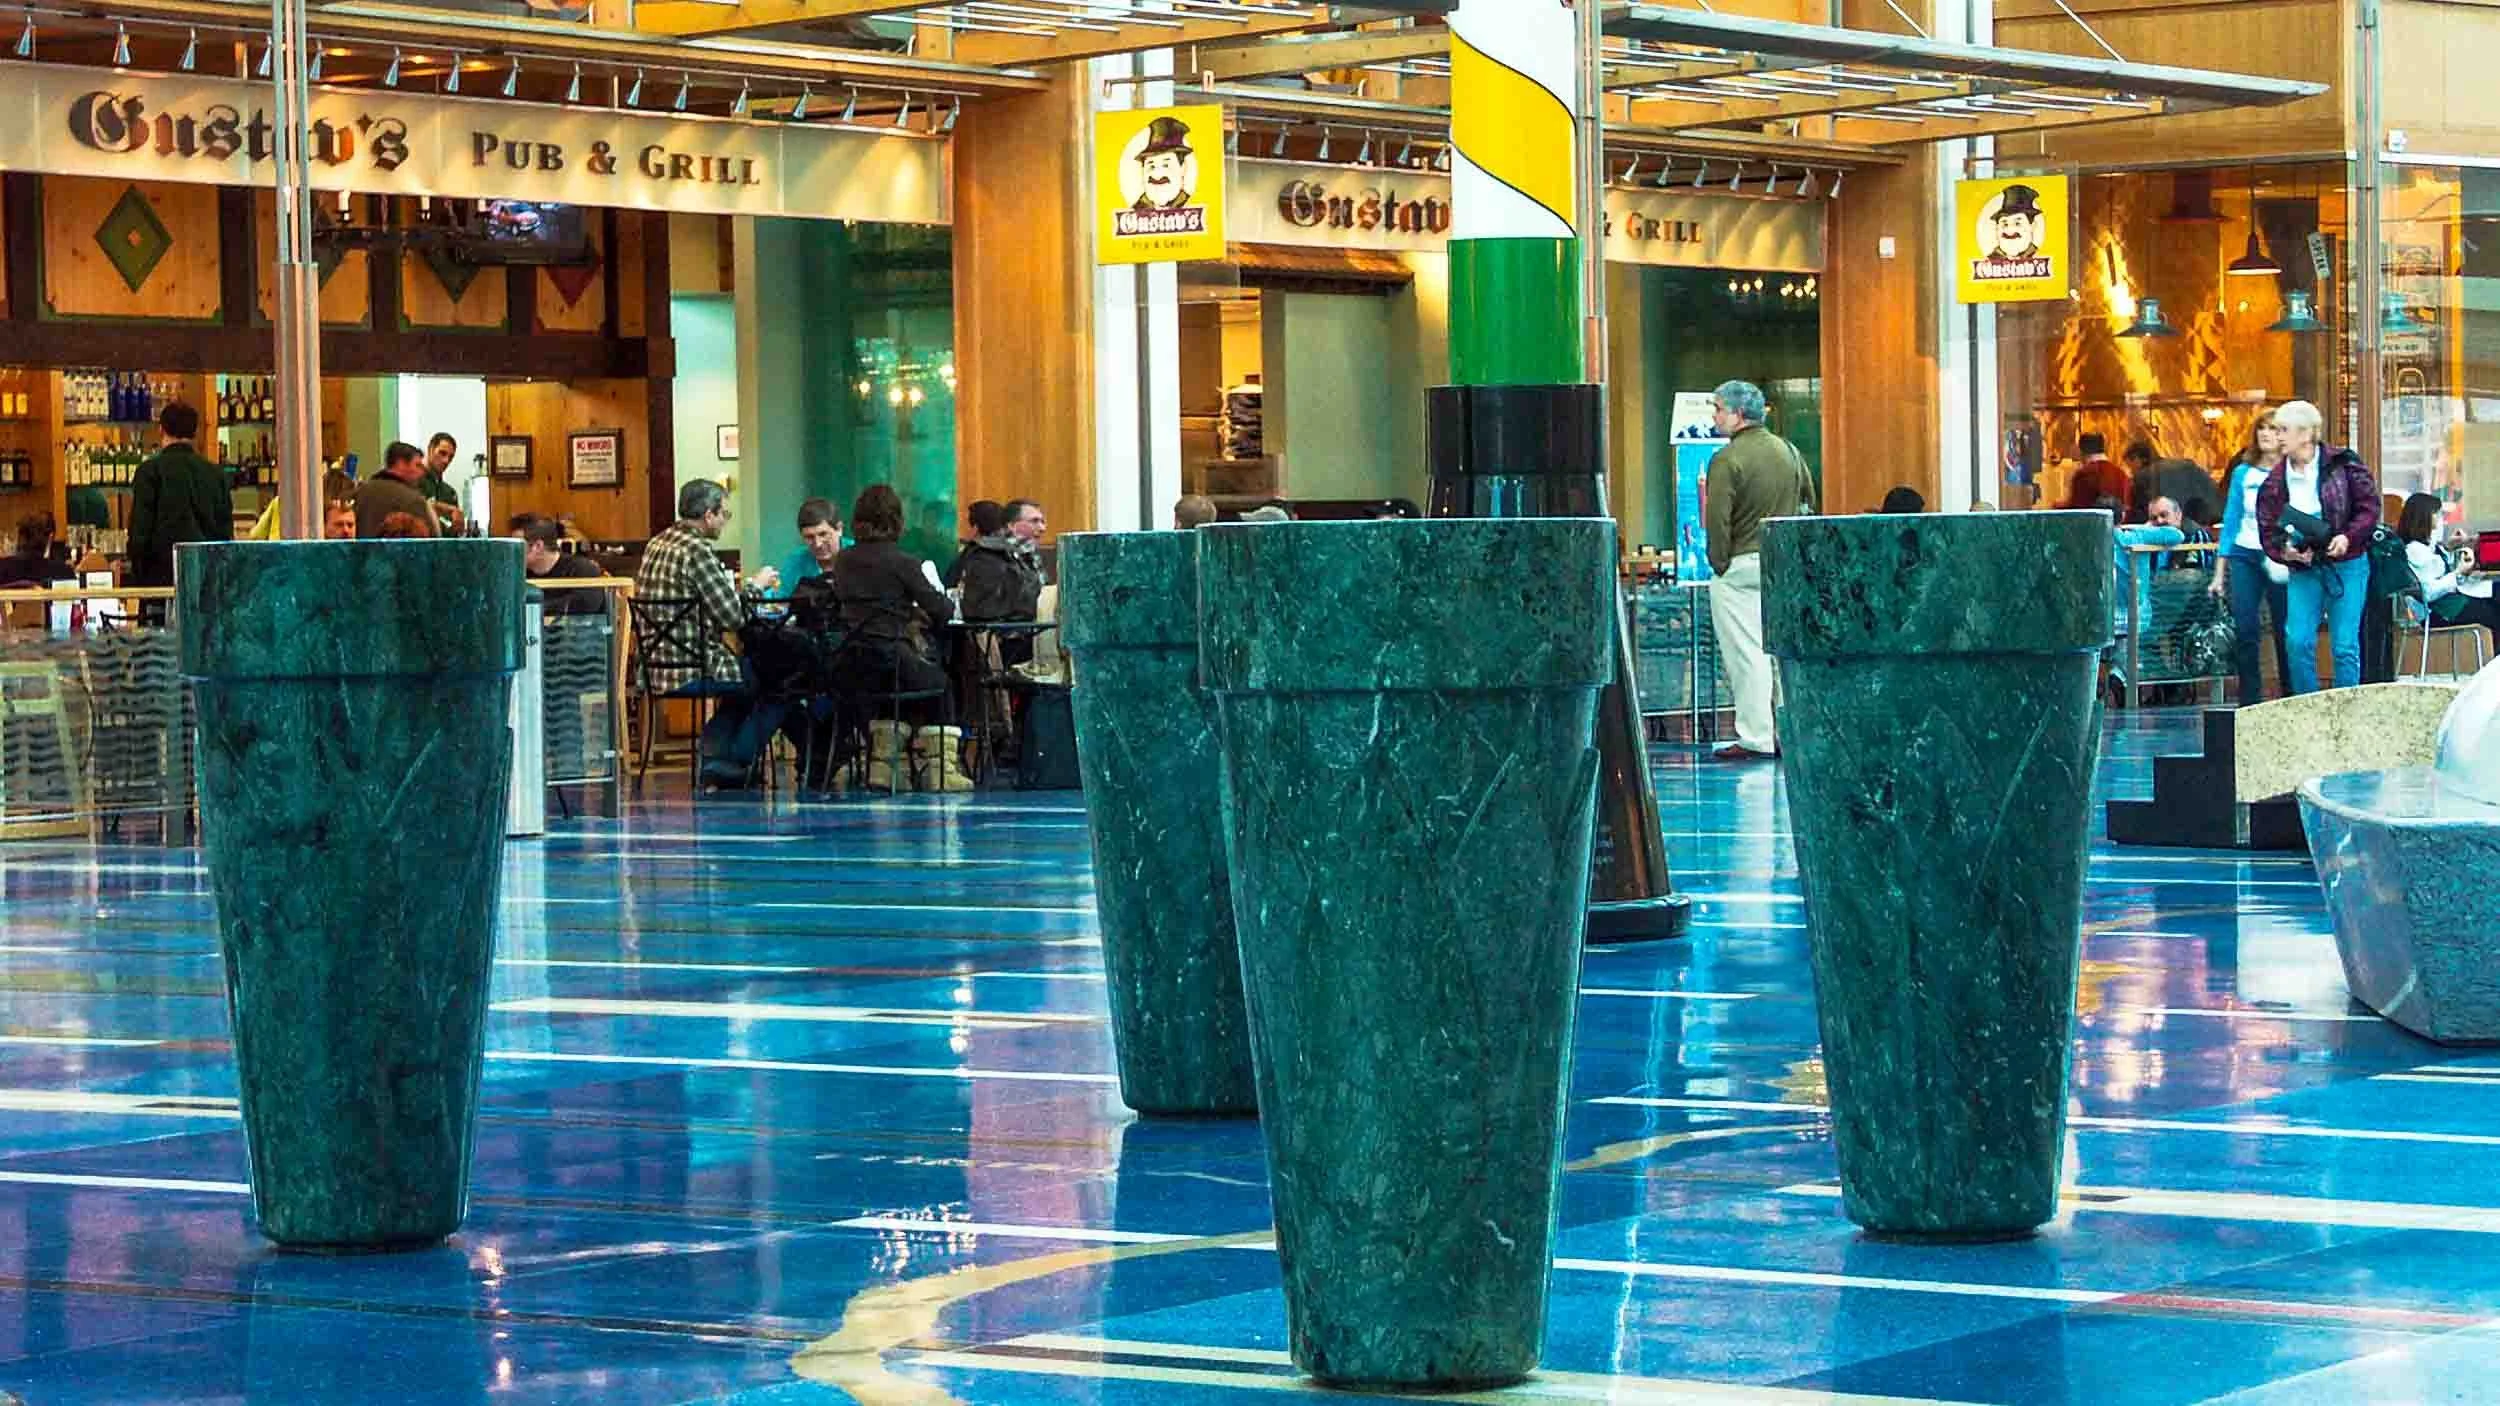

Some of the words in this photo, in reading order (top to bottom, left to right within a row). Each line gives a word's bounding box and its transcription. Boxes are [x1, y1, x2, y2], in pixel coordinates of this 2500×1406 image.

[472, 131, 564, 171] PUB
[586, 140, 616, 175] &
[639, 145, 760, 185] GRILL
[1119, 209, 1201, 234] Gustav's
[1278, 179, 1451, 234] Gustav
[1625, 211, 1702, 243] GRILL
[1975, 259, 2047, 278] Gustav's
